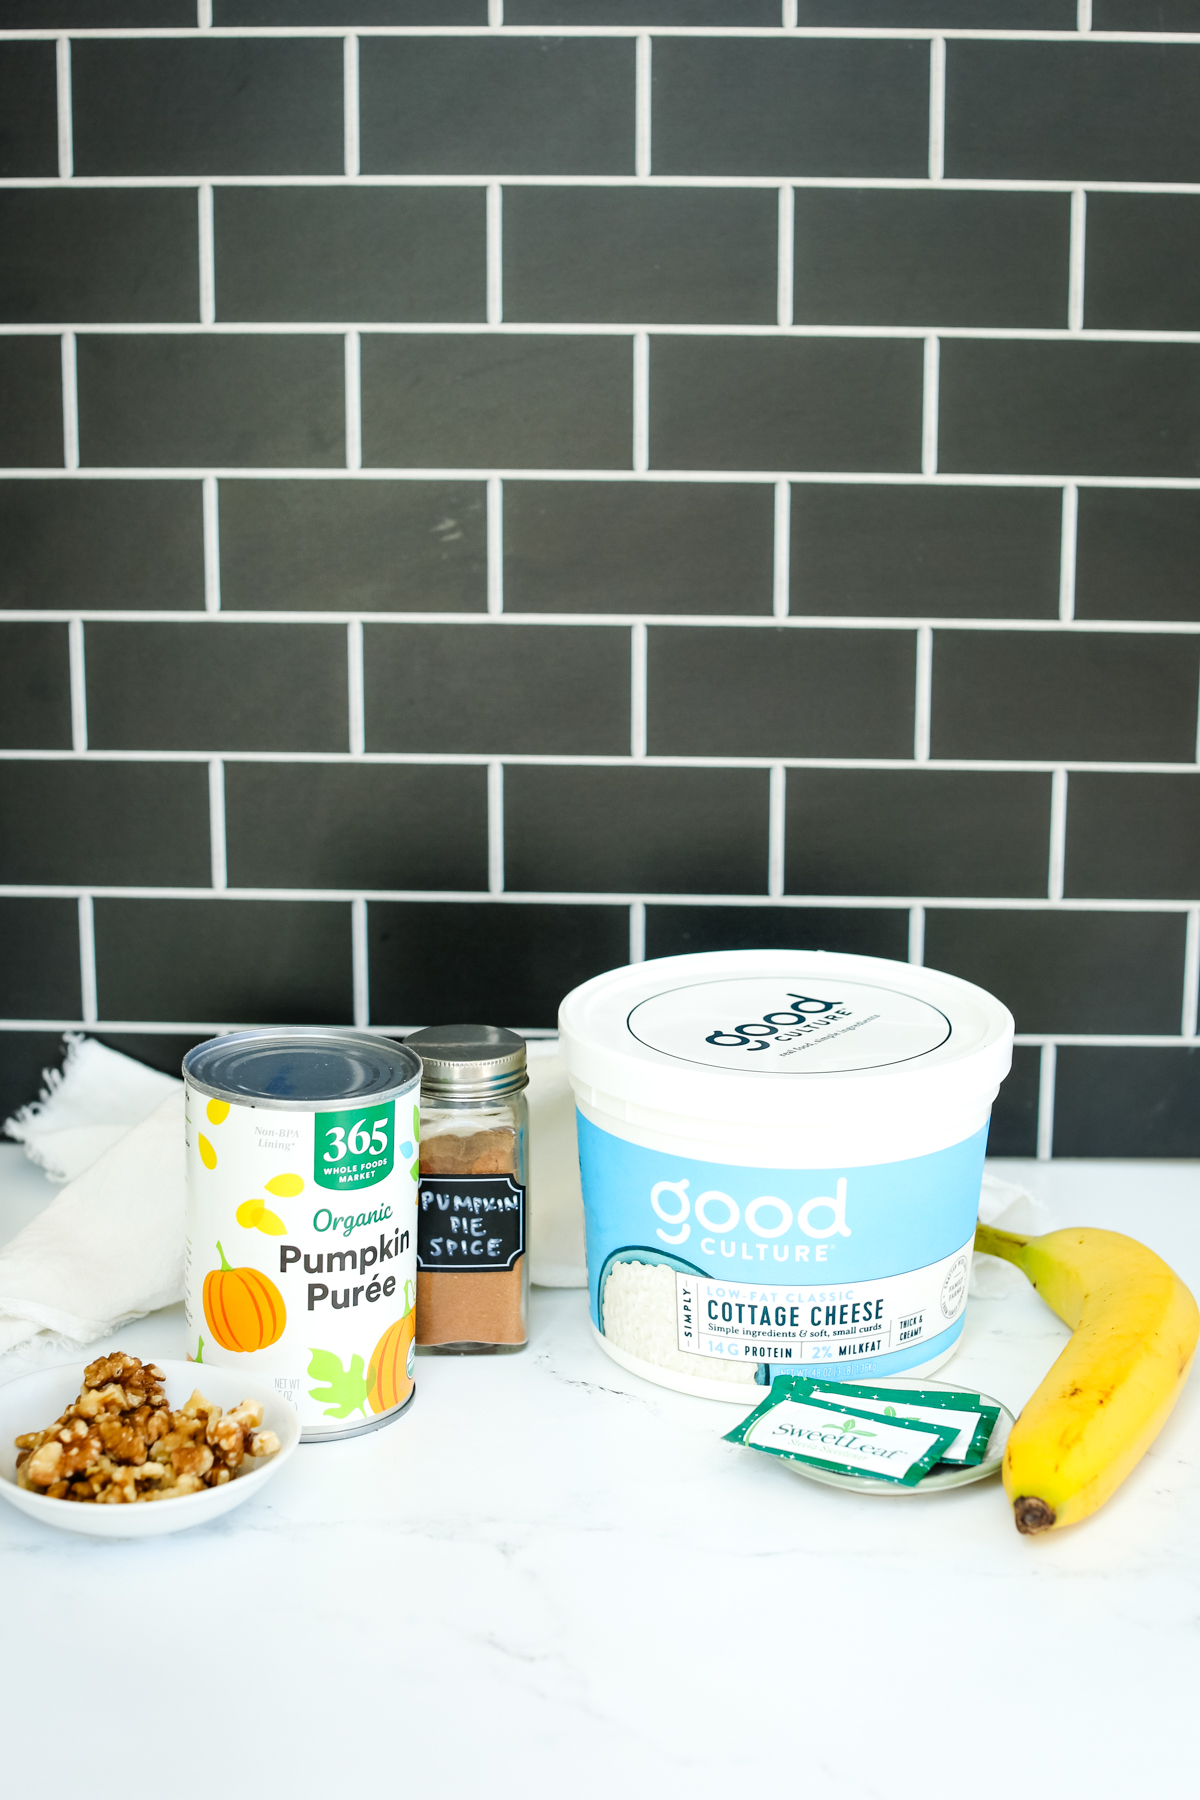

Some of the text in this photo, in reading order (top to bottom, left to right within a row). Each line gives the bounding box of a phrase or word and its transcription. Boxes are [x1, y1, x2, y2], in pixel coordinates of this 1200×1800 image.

[705, 993, 843, 1051] good
[254, 1126, 300, 1139] Non-BPA
[323, 1118, 389, 1162] 365
[323, 1158, 388, 1175] WHOLE FOODS
[338, 1170, 376, 1183] MARKET
[421, 1191, 519, 1214] PUMPKIN
[650, 1177, 852, 1245] good
[312, 1202, 394, 1238] Organic
[450, 1216, 487, 1237] PIE
[279, 1227, 410, 1275] Pumpkin
[430, 1237, 502, 1257] SPICE
[307, 1273, 396, 1311] Purée
[707, 1286, 854, 1303] LOW-FAT CLASSIC
[682, 1288, 692, 1338] SIMPLY
[707, 1299, 884, 1327] COTTAGE CHEESE
[708, 1323, 882, 1338] Simple ingredients & soft, small curds
[900, 1317, 917, 1329] THICK
[899, 1326, 922, 1341] CREAMY
[708, 1340, 792, 1358] 14G PROTEIN
[812, 1340, 881, 1359] 2% MILKFAT
[812, 1368, 820, 1378] 48
[823, 1367, 832, 1377] OZ
[274, 1378, 300, 1389] NET WT
